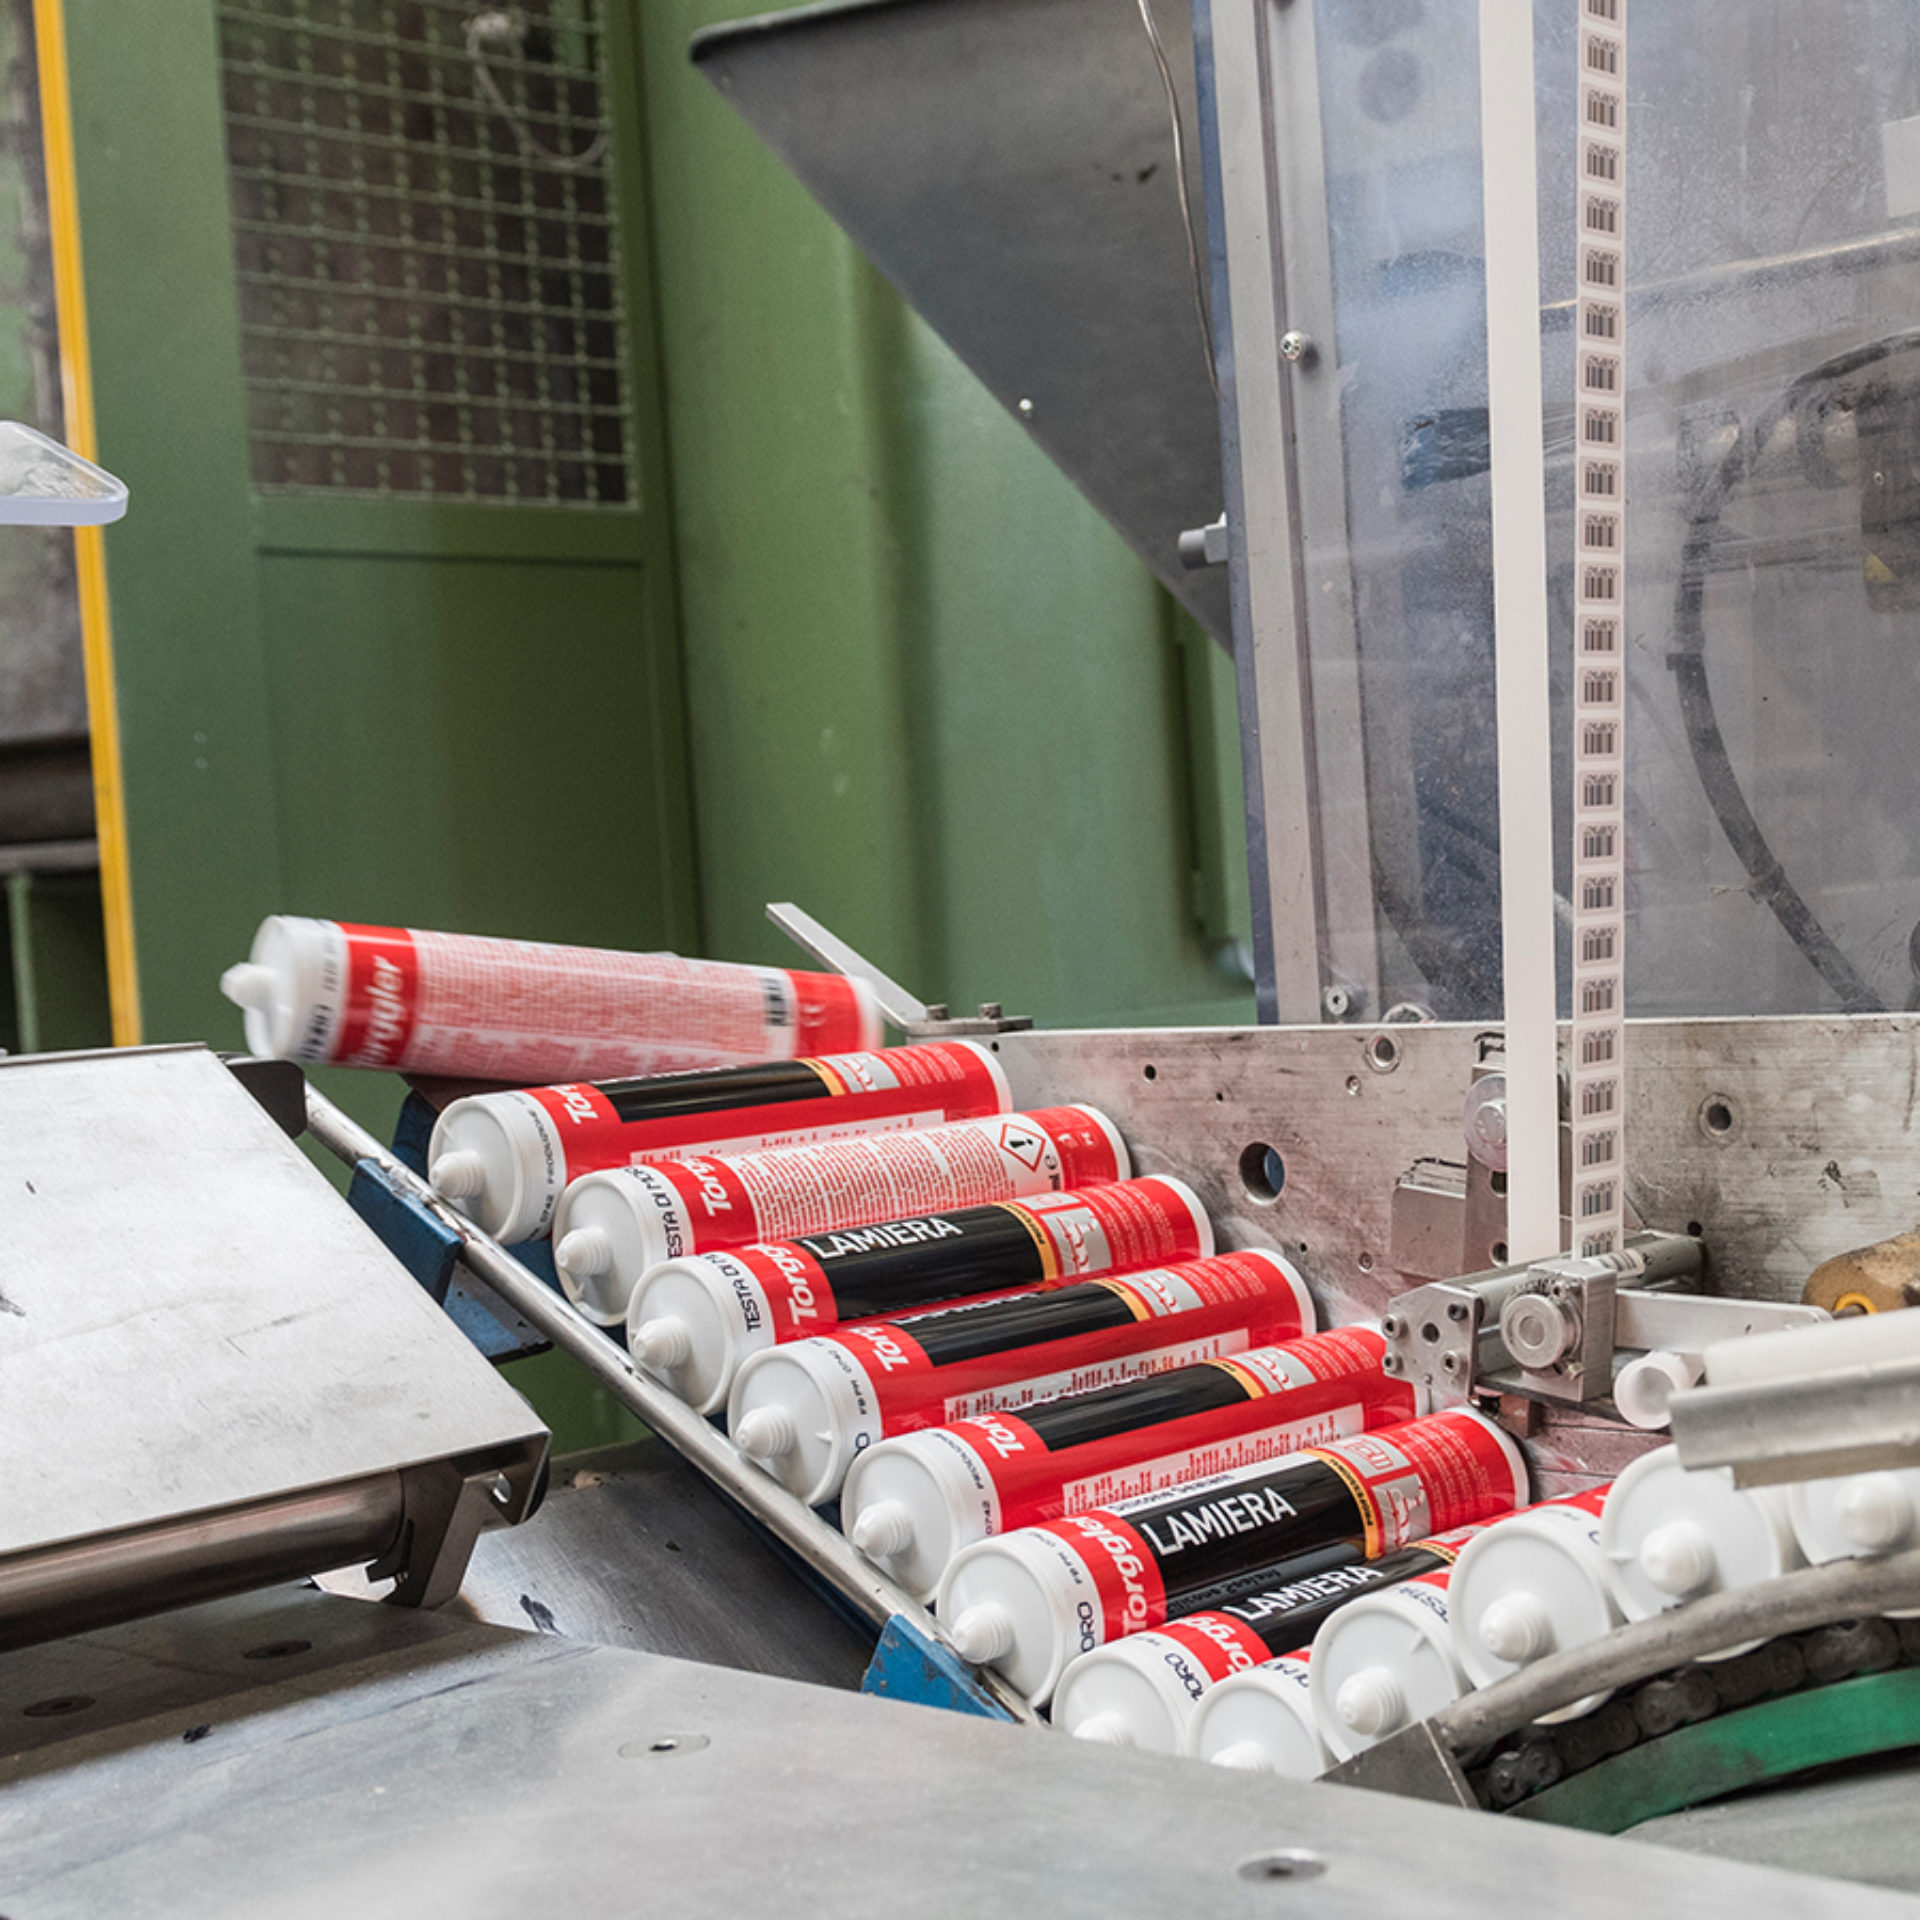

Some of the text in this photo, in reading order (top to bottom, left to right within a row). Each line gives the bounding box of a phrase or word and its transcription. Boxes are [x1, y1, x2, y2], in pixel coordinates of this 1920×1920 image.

[801, 1217, 963, 1260] LAMIERA
[732, 1278, 762, 1333] TESTA
[1140, 1486, 1298, 1556] LAMIERA
[1221, 1565, 1385, 1621] LAMIERA
